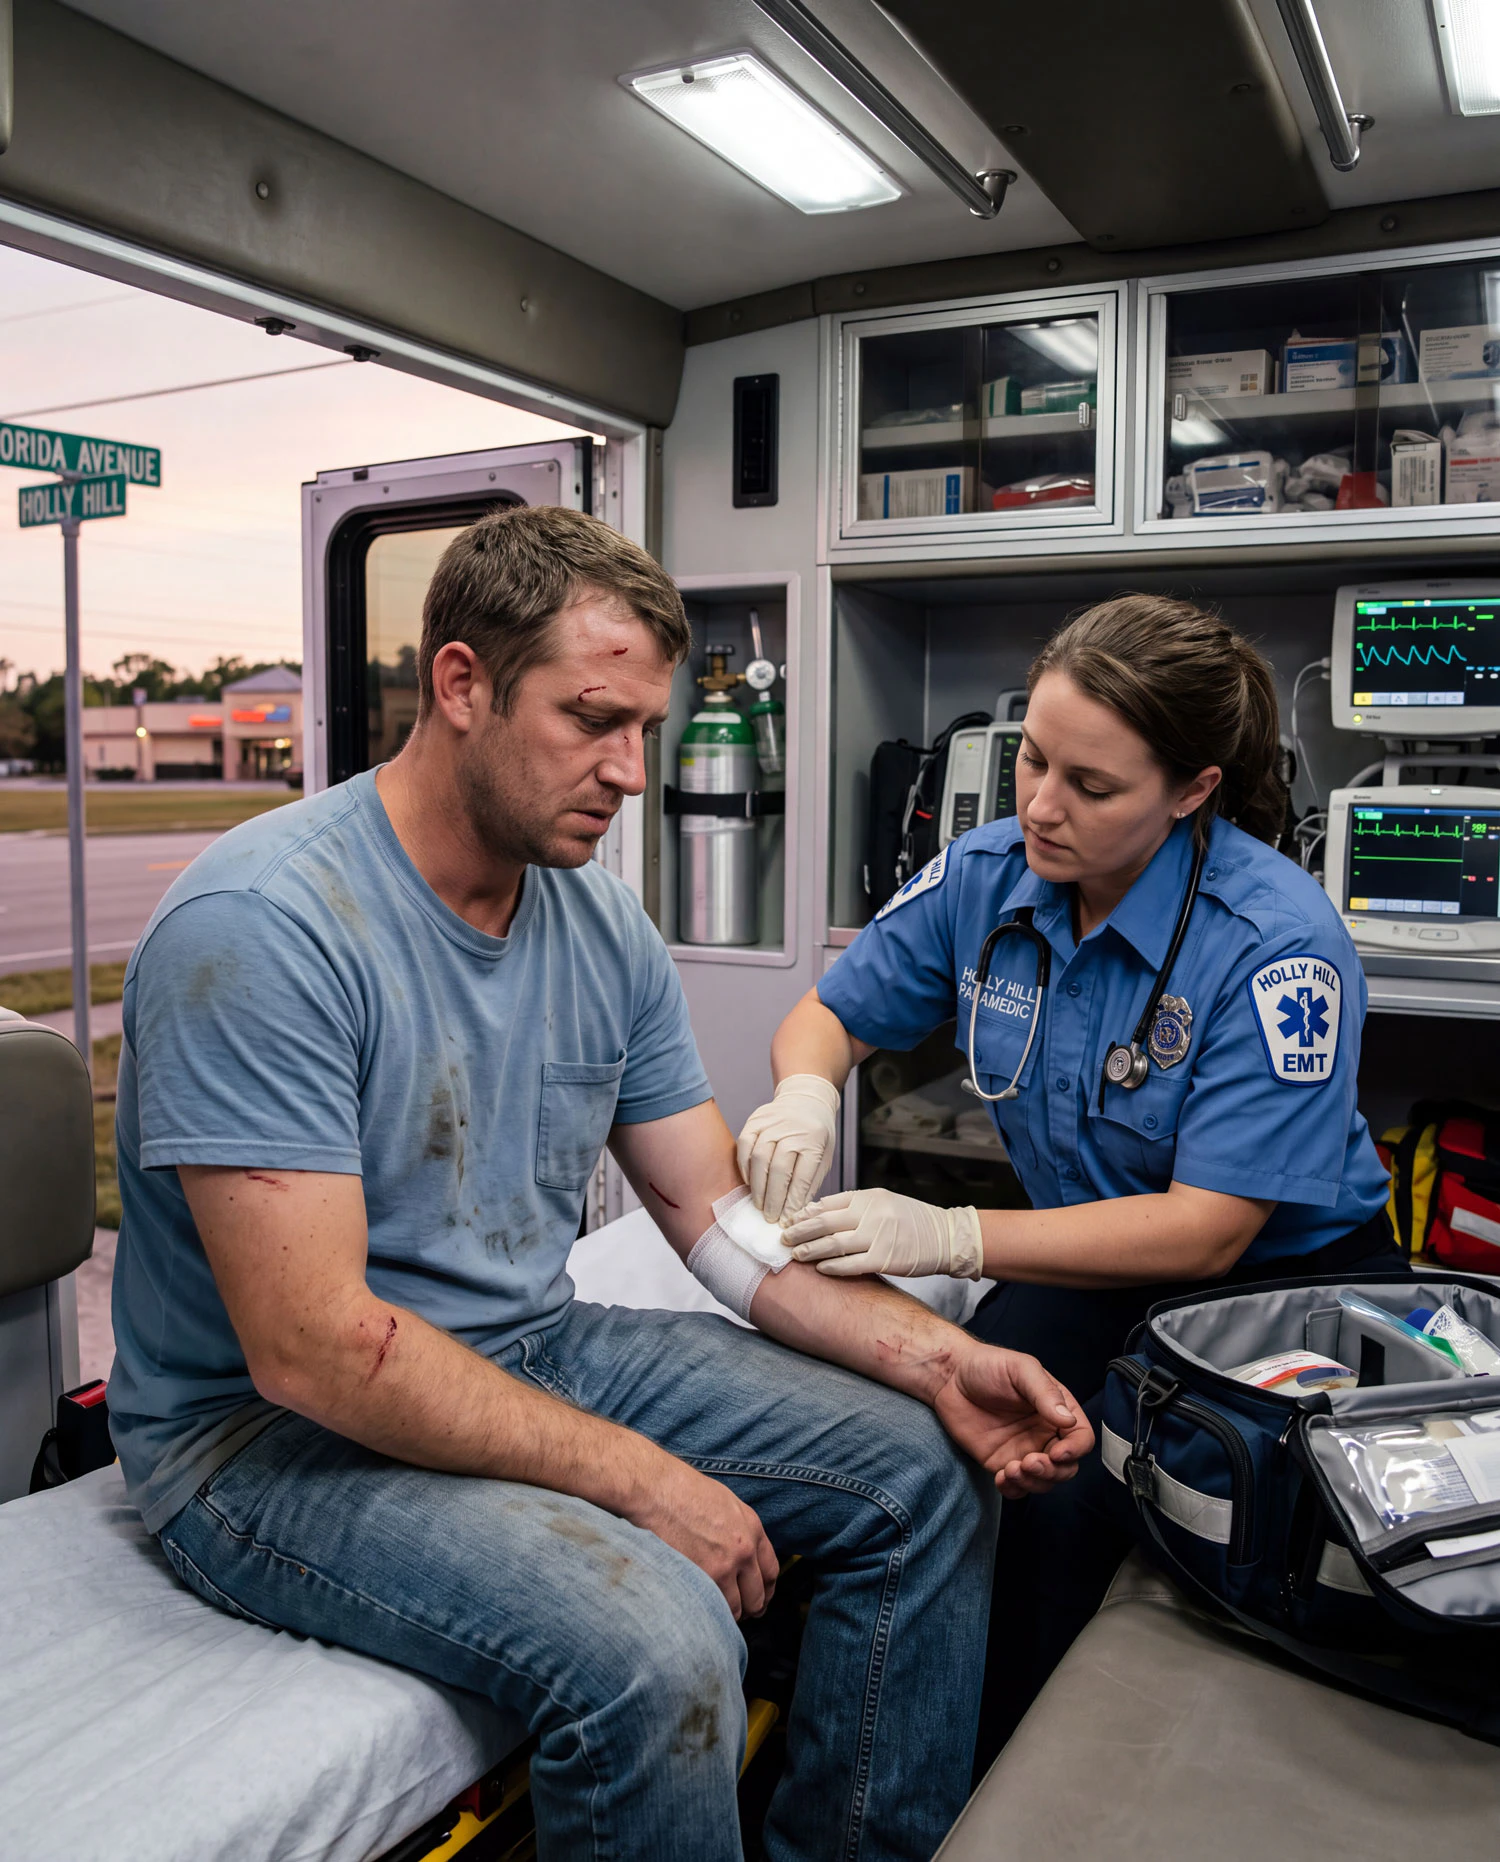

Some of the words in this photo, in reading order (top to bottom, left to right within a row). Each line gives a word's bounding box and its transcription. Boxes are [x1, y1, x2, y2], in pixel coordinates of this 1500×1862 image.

[77, 440, 158, 483] AVENUE
[21, 486, 75, 523] HOLLY
[82, 480, 123, 515] HILL
[928, 859, 943, 884] HILL
[962, 966, 1005, 992] HOLY
[1005, 981, 1036, 1003] HILL
[1257, 963, 1308, 992] HOLLY
[1312, 964, 1336, 992] HILL
[1283, 1053, 1327, 1073] EMT
